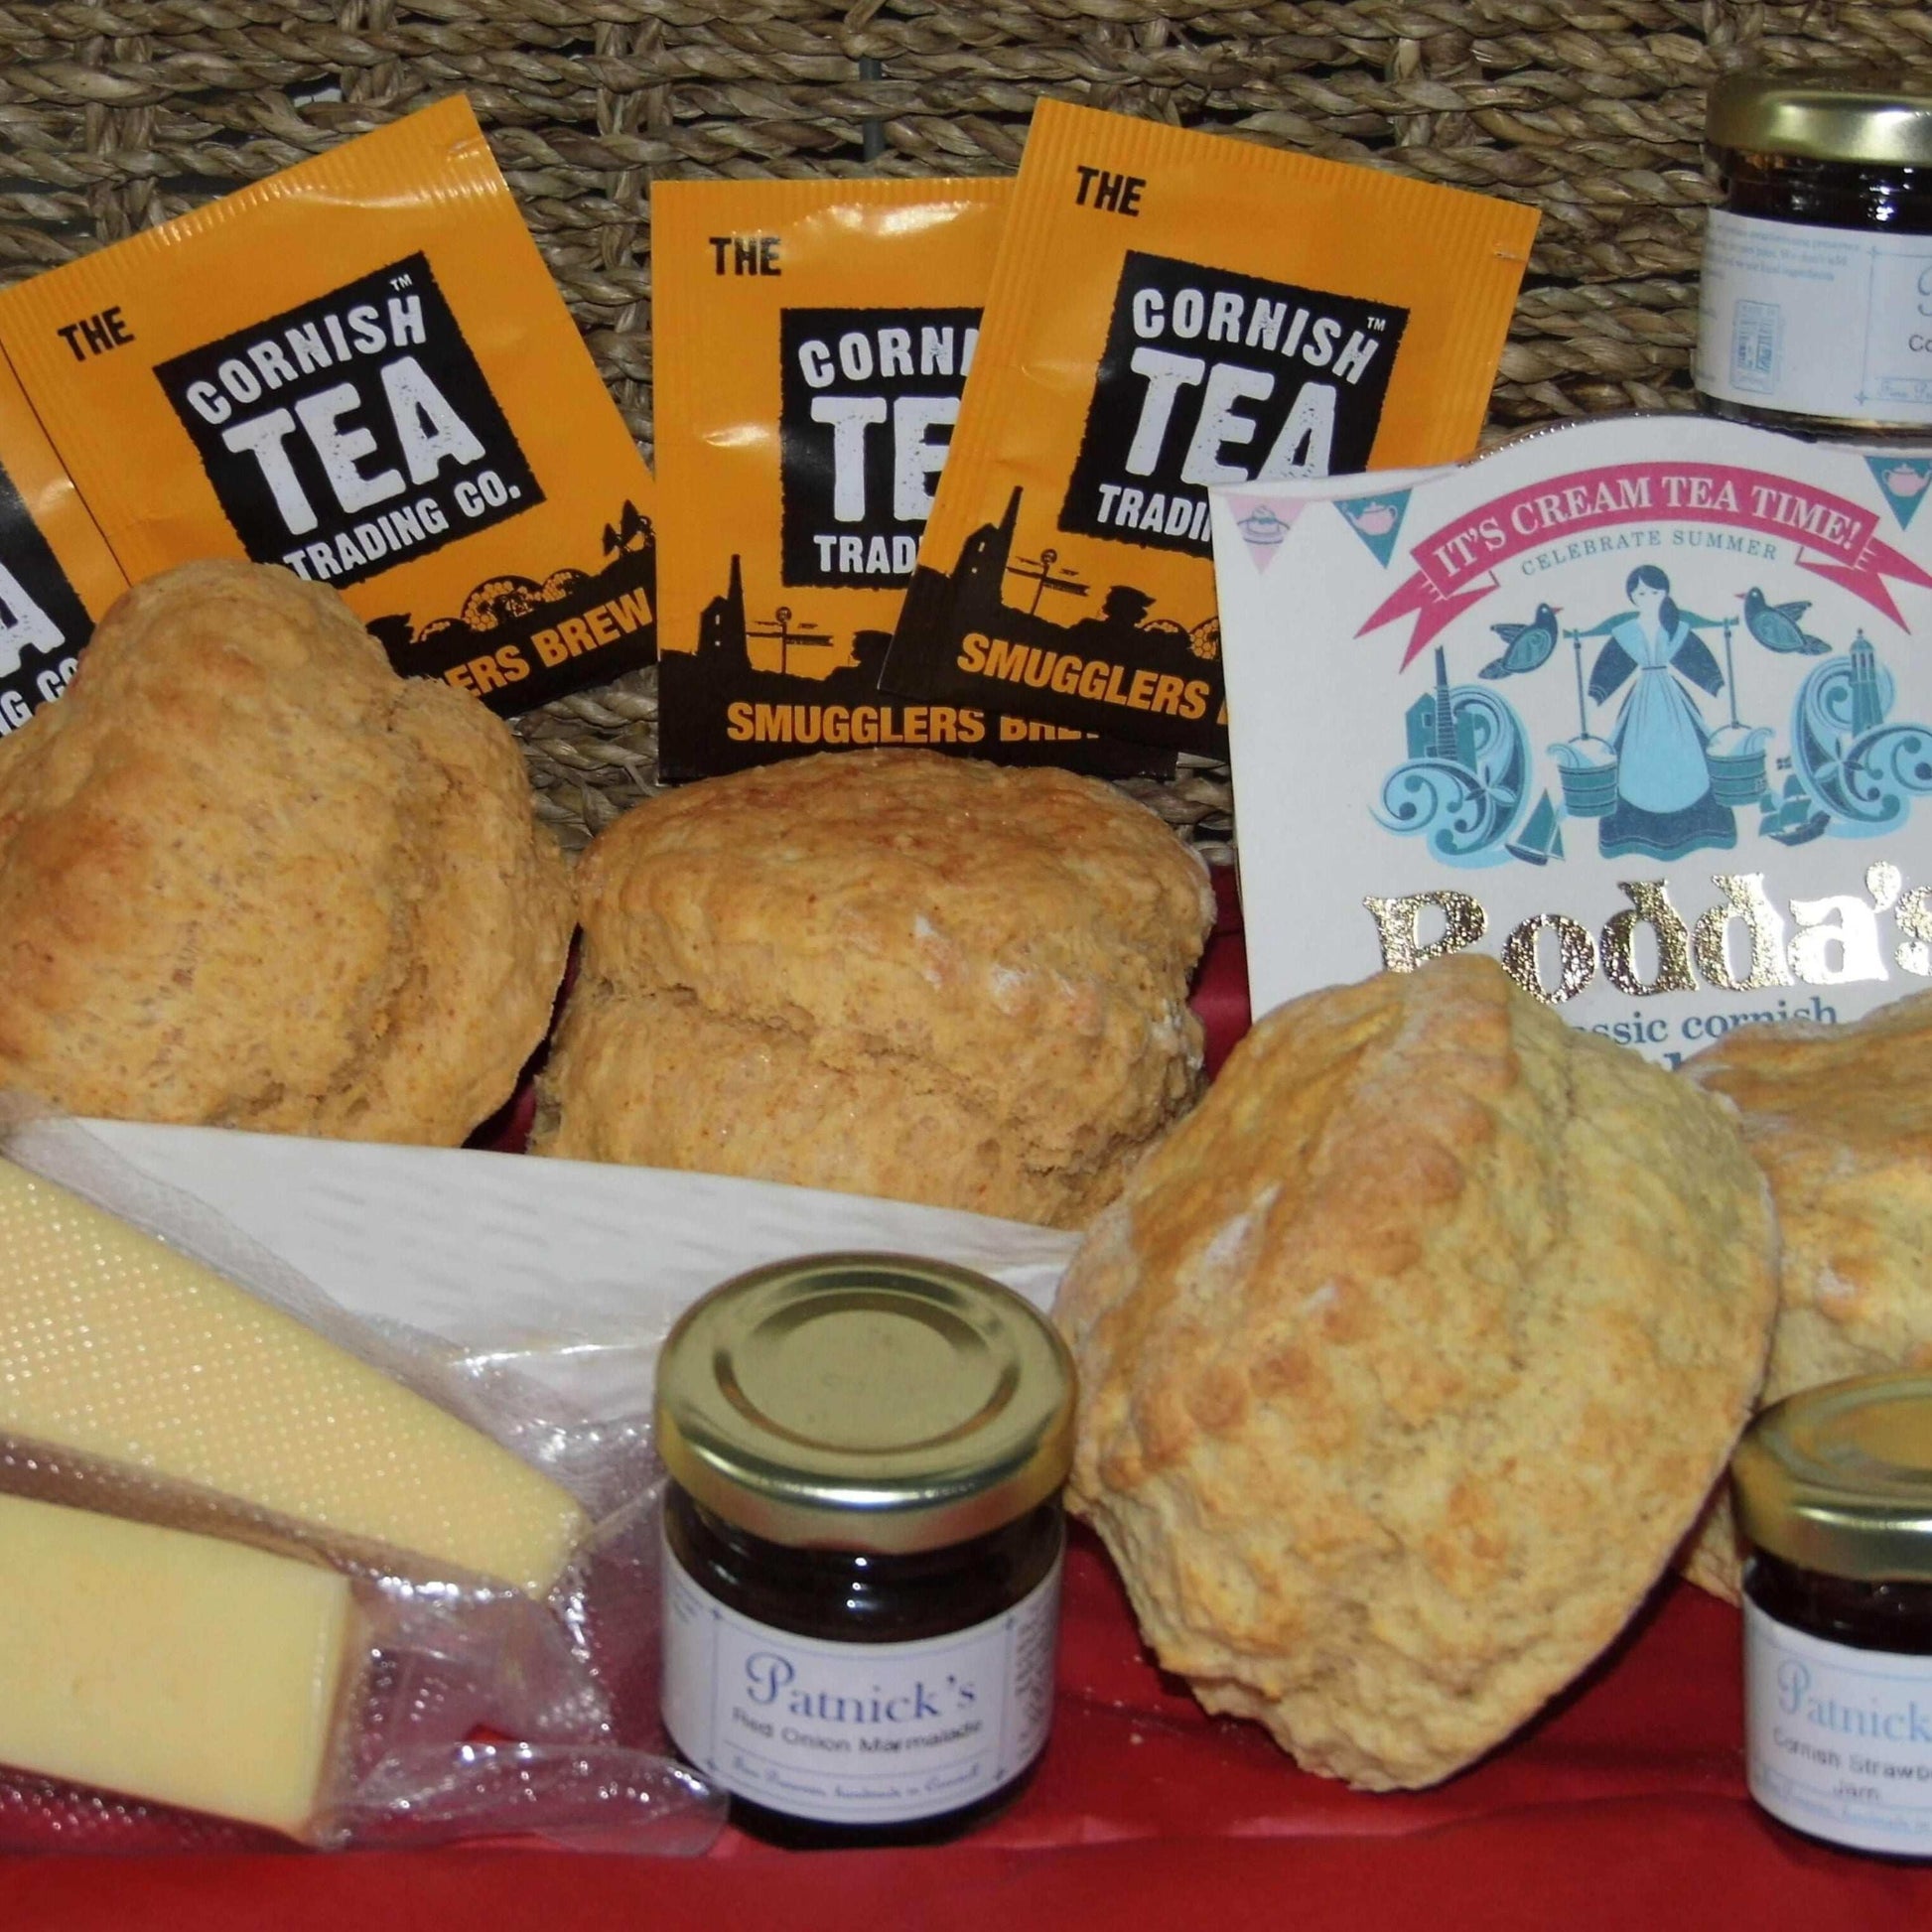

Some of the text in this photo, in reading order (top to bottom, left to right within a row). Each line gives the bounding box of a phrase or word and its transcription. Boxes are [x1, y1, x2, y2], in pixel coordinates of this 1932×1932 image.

[1076, 165, 1147, 217] THE
[708, 235, 782, 277] THE
[57, 306, 135, 362] THE
[186, 294, 427, 425] CORNISH
[797, 326, 981, 388] CORNI
[1132, 287, 1379, 385] CORNISH
[220, 354, 486, 536] TEA
[1125, 346, 1337, 485] TEA
[809, 396, 962, 522] TE
[282, 470, 522, 583] TRADING CO.
[1432, 476, 1863, 579] IT'S CREAM TEA TIME!
[1520, 529, 1778, 578] CELEBRATE SUMMER
[530, 587, 653, 668] BREW
[956, 632, 1211, 721] SMUGGLERS
[726, 701, 986, 744] SMUGGLERS
[780, 1725, 851, 1753] Onion
[1776, 1659, 1932, 1742] Patnick
